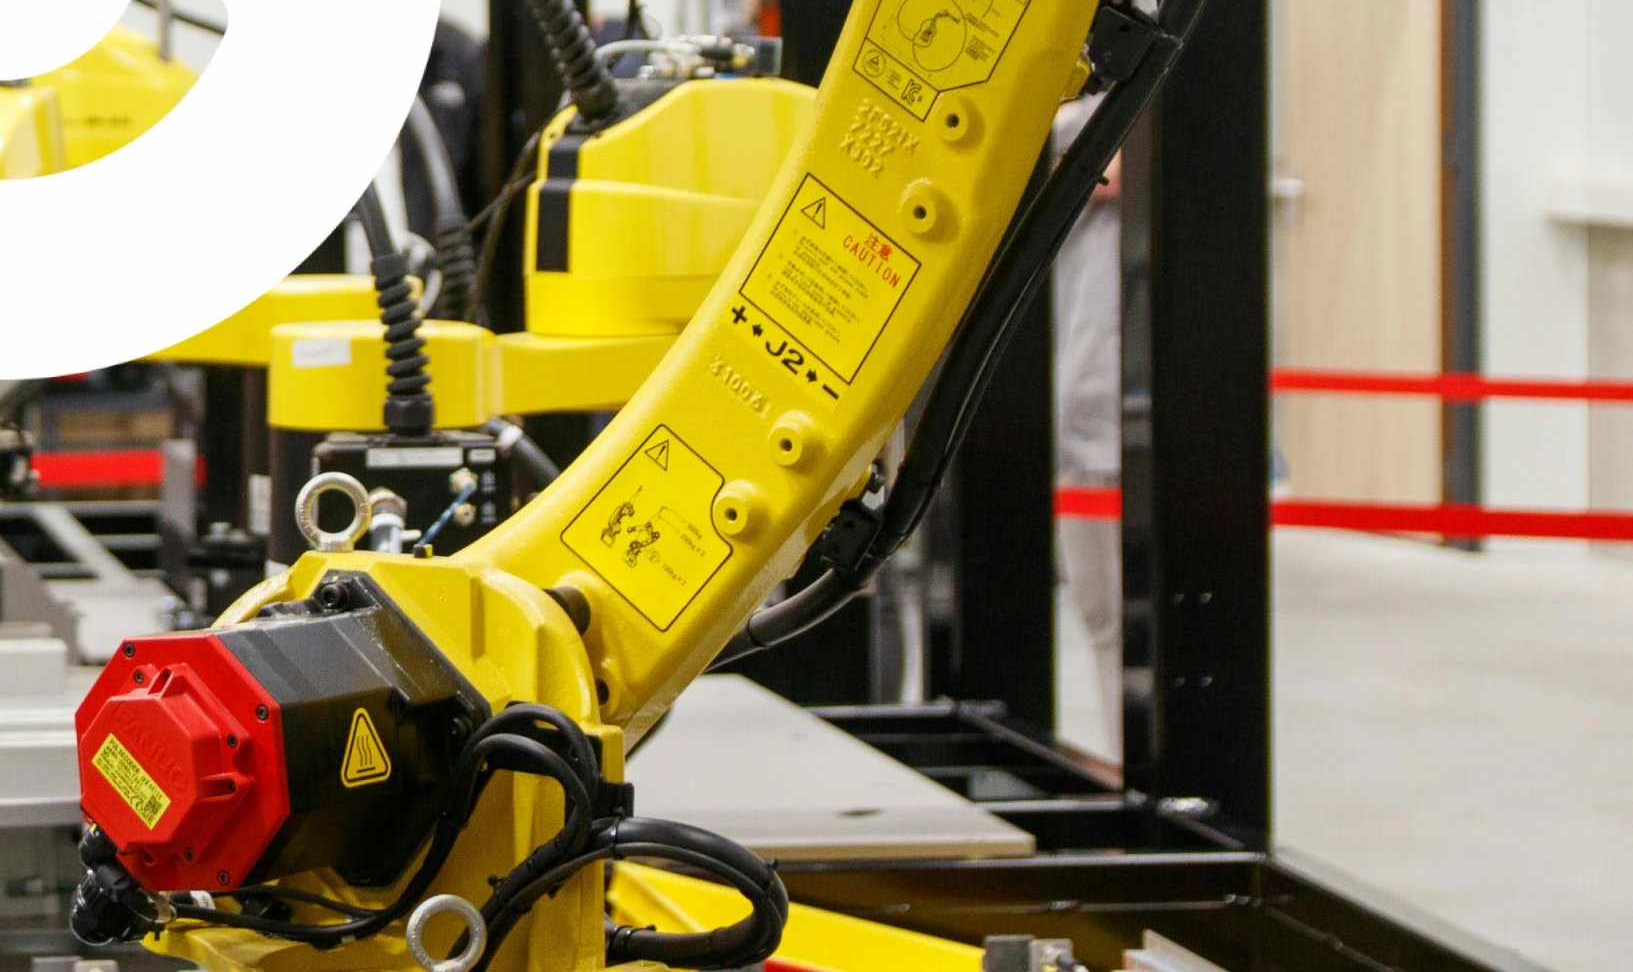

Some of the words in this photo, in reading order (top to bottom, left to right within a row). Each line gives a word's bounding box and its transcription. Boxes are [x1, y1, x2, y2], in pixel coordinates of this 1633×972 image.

[843, 235, 900, 288] CAUTION
[864, 233, 893, 261] 注意
[765, 339, 805, 376] J2
